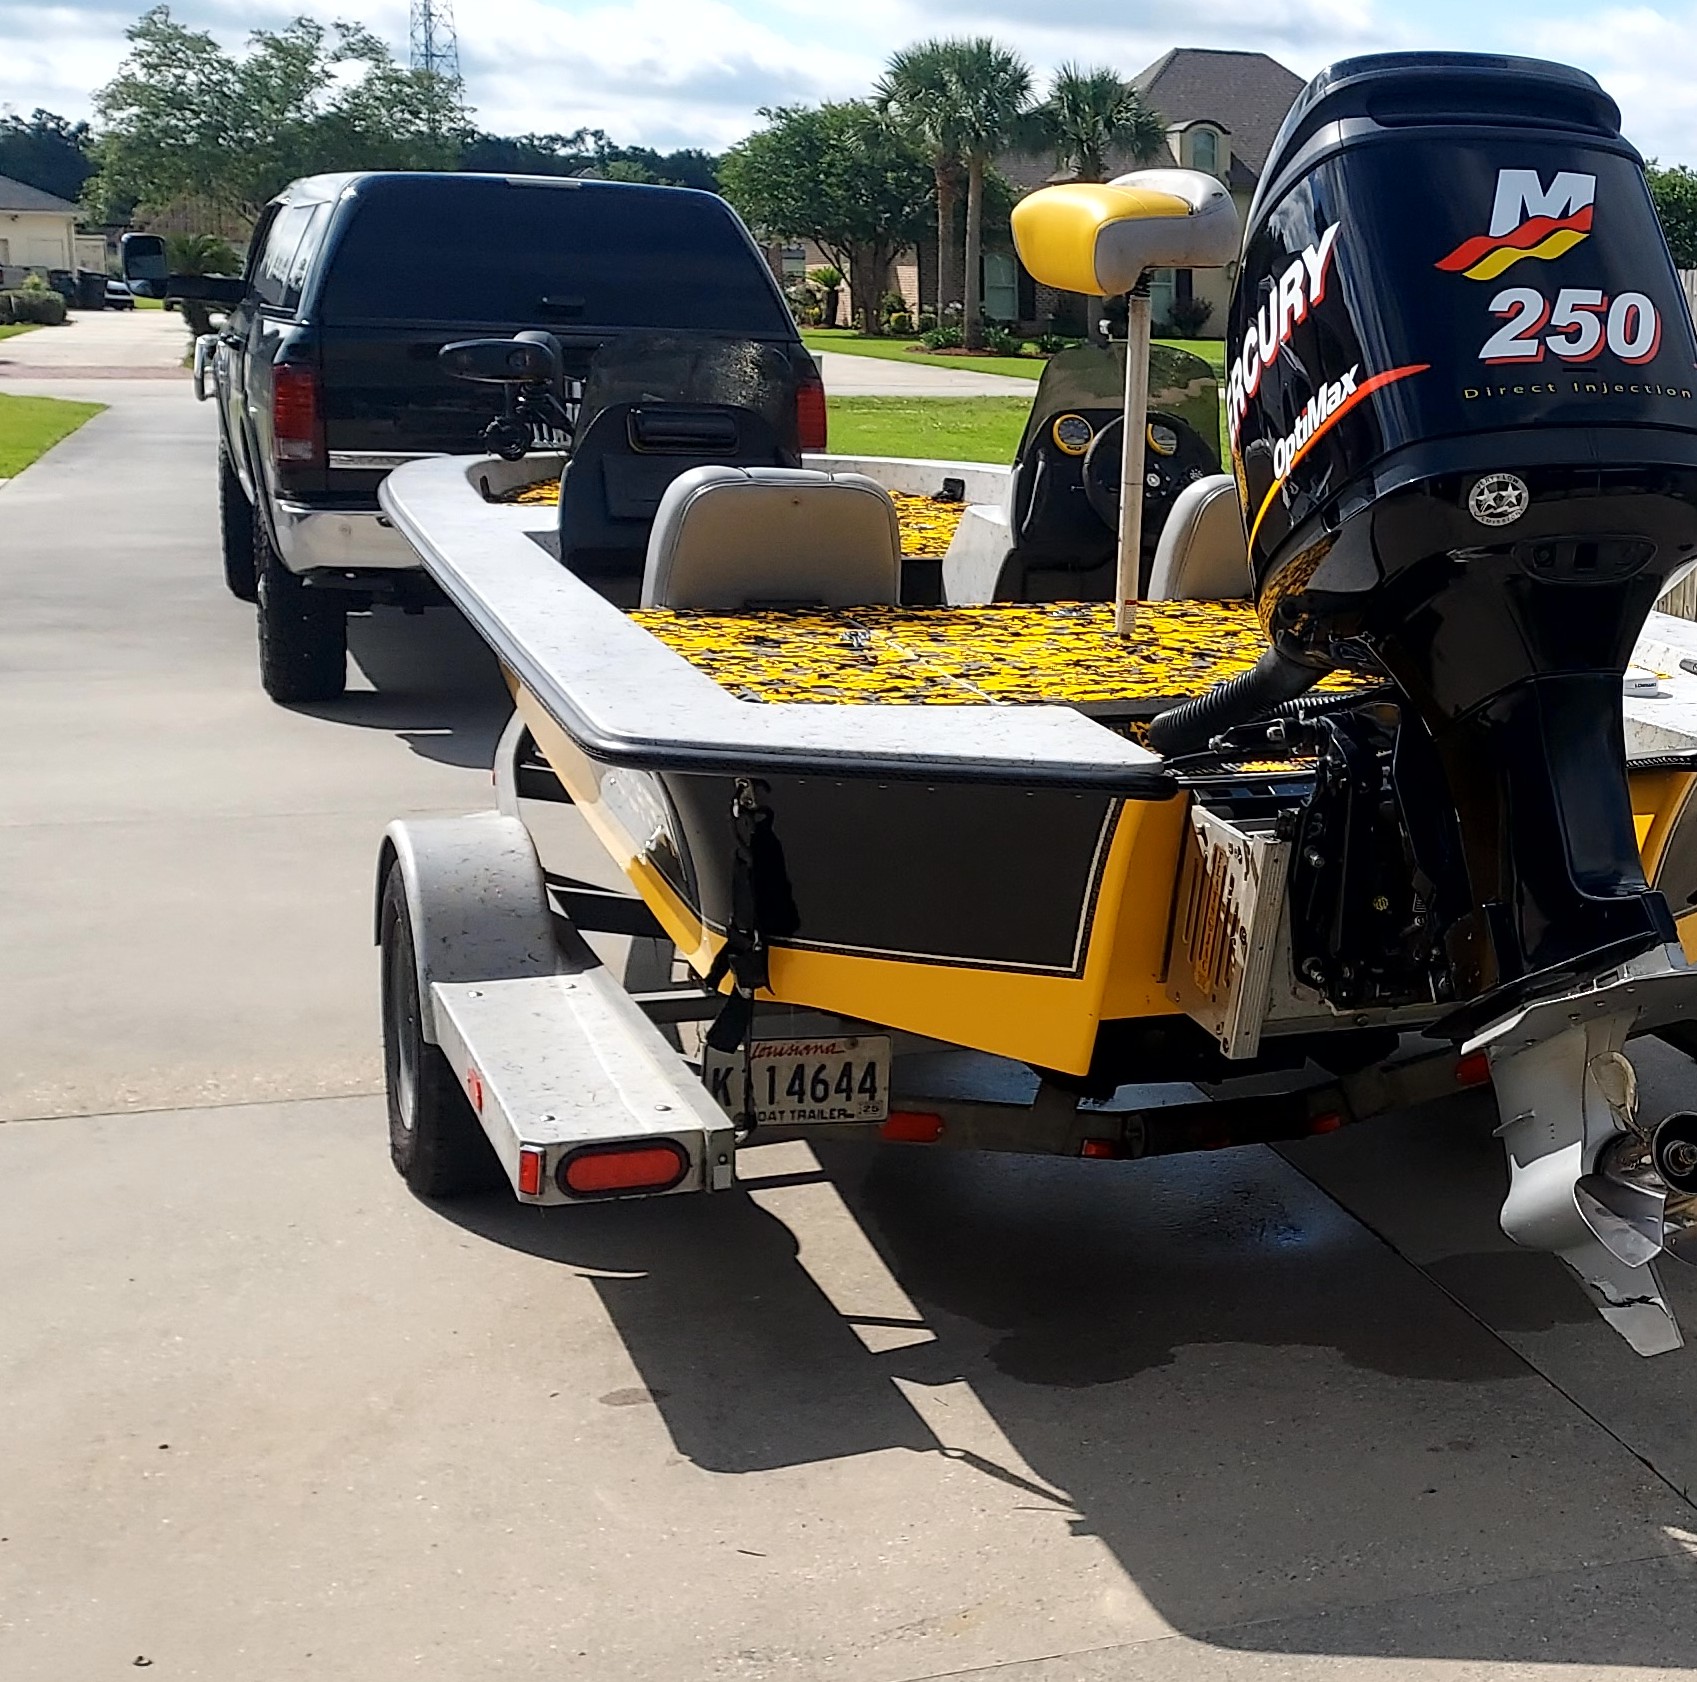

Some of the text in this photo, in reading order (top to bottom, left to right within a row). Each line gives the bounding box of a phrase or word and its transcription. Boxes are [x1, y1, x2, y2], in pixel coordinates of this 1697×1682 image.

[1227, 220, 1342, 448] ERCURY
[1479, 287, 1661, 365] 250
[1463, 382, 1692, 399] Direct Injection
[1273, 363, 1360, 480] OptiMax
[750, 1042, 846, 1060] Louisiana
[712, 1061, 878, 1107] K14644
[757, 1108, 848, 1121] OAT TRAILER
